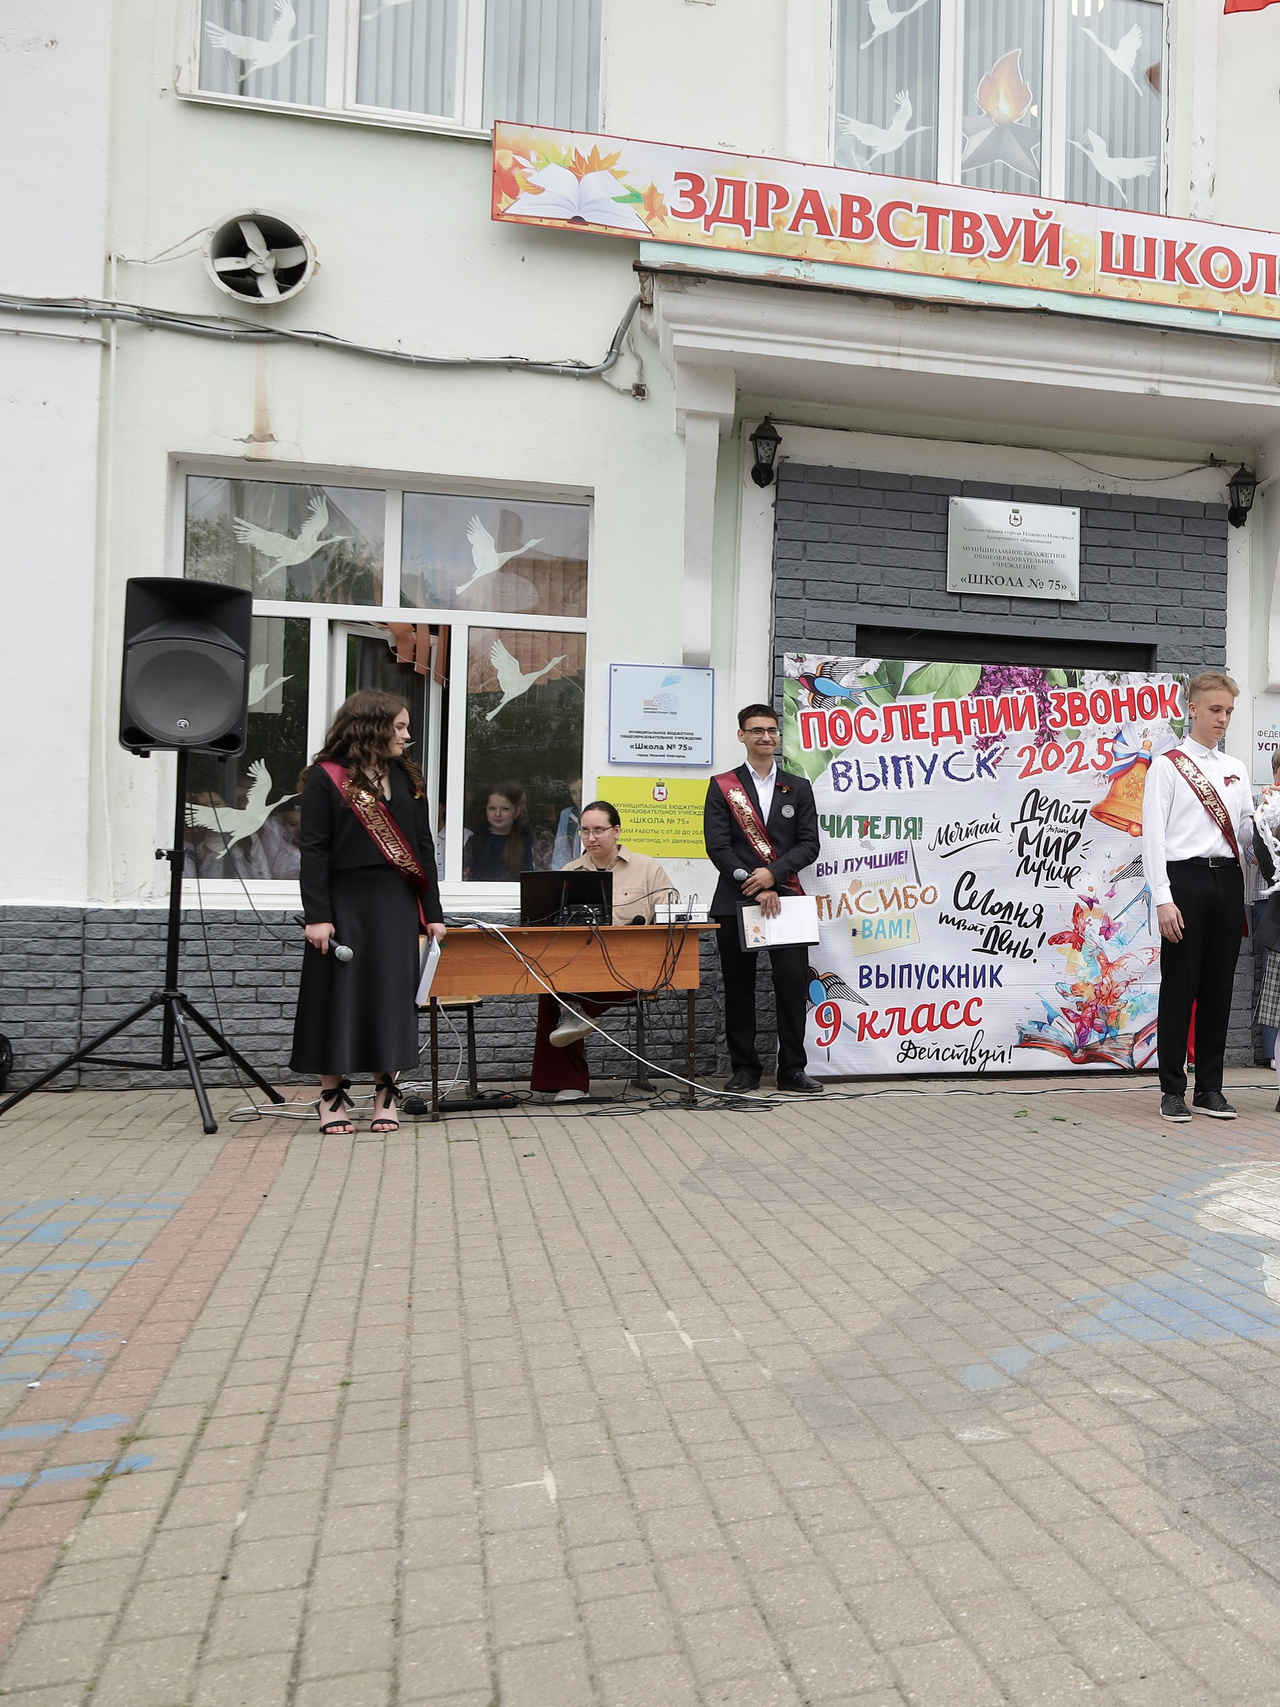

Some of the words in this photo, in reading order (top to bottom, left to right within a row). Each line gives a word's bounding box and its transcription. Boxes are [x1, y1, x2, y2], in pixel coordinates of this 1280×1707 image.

[670, 171, 1079, 277] ЗДРАВСТВУЙ,
[974, 554, 1055, 565] ОБЩЕОБРАЗОВАТЕЛЬНОЕ
[992, 562, 1037, 570] УЧРЕЖДЕНИЕ
[1024, 551, 1067, 559] БЮДЖЕТНОЕ
[960, 573, 1024, 588] «ШКОЛА
[1028, 577, 1045, 589] №
[1048, 580, 1067, 590] 75»
[800, 690, 1038, 749] ПОСЛЕДНИЙ
[1049, 684, 1182, 728] ЗВОНОК
[831, 742, 1001, 793] ВЫПУСК
[1016, 737, 1117, 780] 2025
[818, 814, 923, 840] ЧИТЕЛЯ!
[1011, 788, 1091, 833] Делай
[928, 813, 1003, 852] Мечтай
[1018, 826, 1081, 865] Мир
[816, 862, 838, 877] ВЫ
[842, 850, 908, 873] ЛУЧШИЕ!
[815, 885, 938, 921] ПАСИБО
[953, 870, 1044, 929] Сегодня
[861, 918, 911, 940] ВАМ!
[938, 912, 986, 935] твой
[972, 925, 1047, 964] День!
[859, 963, 1003, 990] ВЫПУСКНИК
[815, 1001, 842, 1047] 9
[857, 997, 983, 1042] класс
[897, 1029, 1013, 1073] Действуй!
